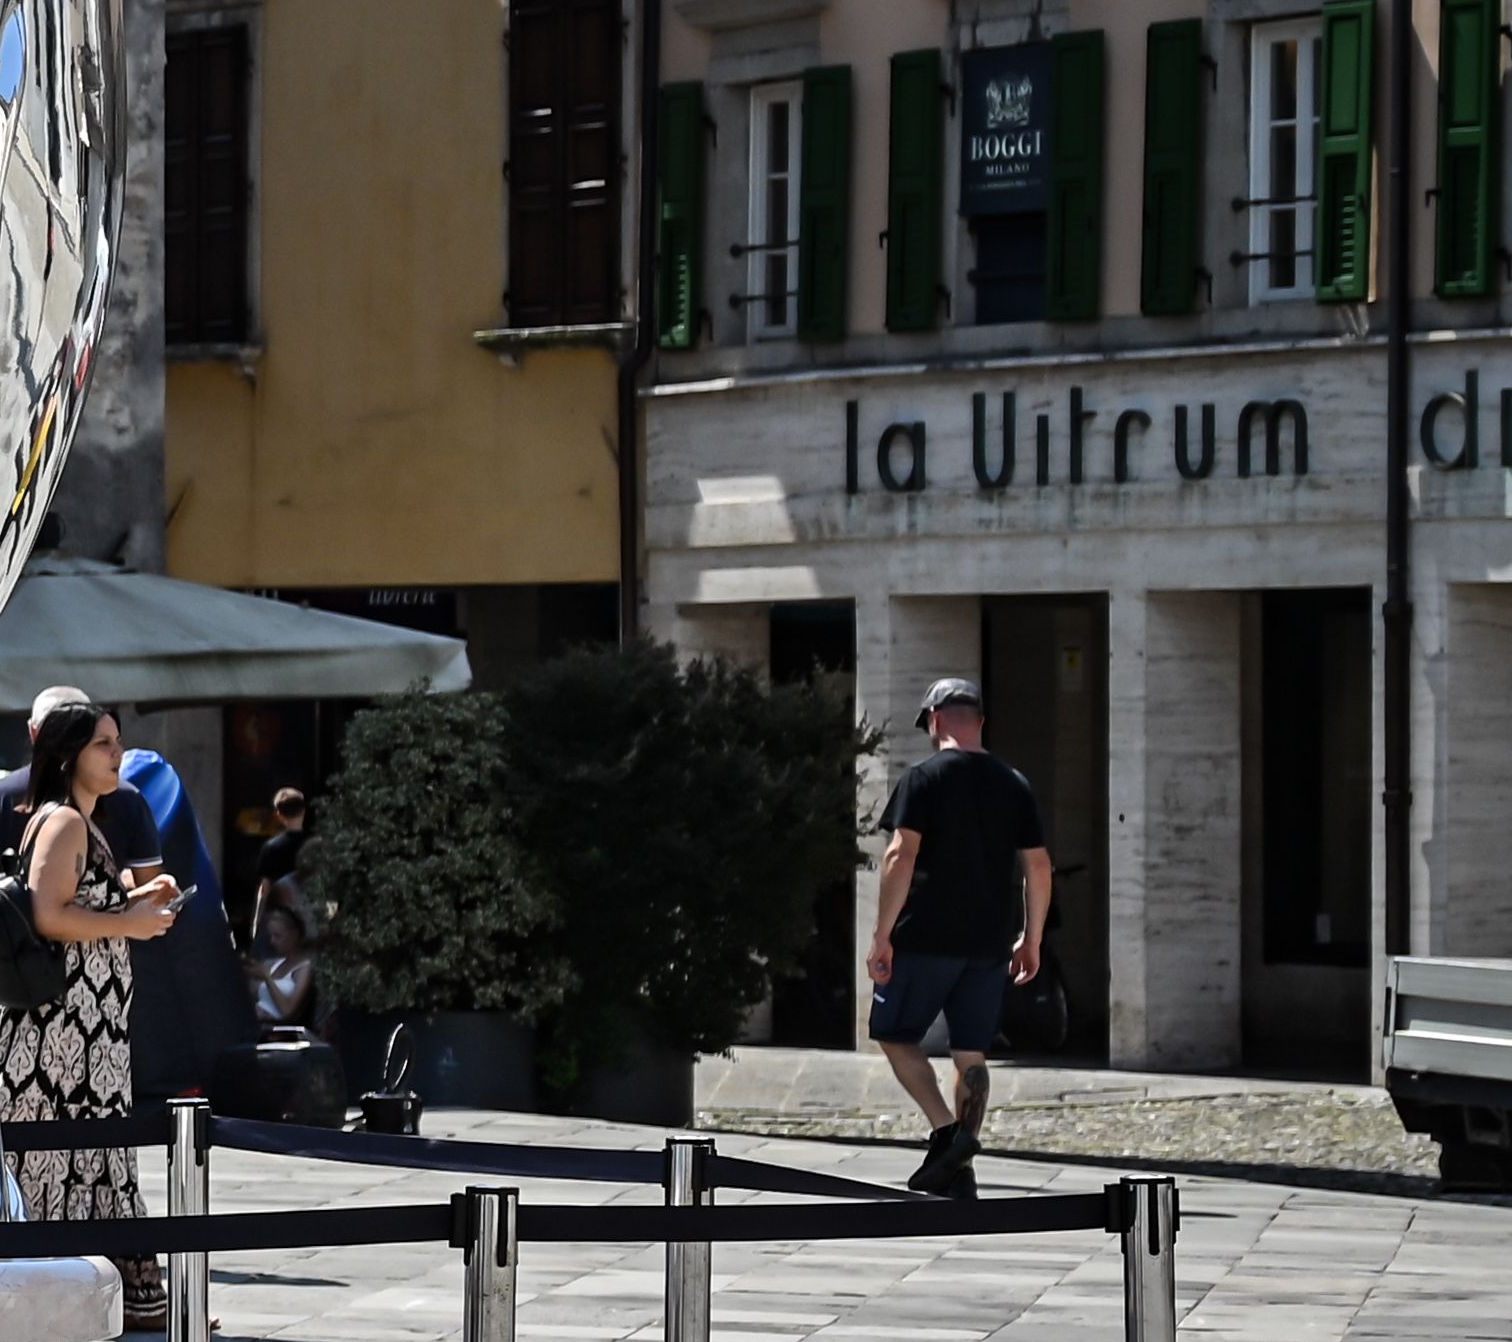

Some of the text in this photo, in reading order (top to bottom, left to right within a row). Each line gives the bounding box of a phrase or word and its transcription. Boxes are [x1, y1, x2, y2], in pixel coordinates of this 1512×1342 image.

[971, 130, 1041, 160] BOGGI
[985, 162, 1030, 176] MILANO
[845, 399, 926, 495] la
